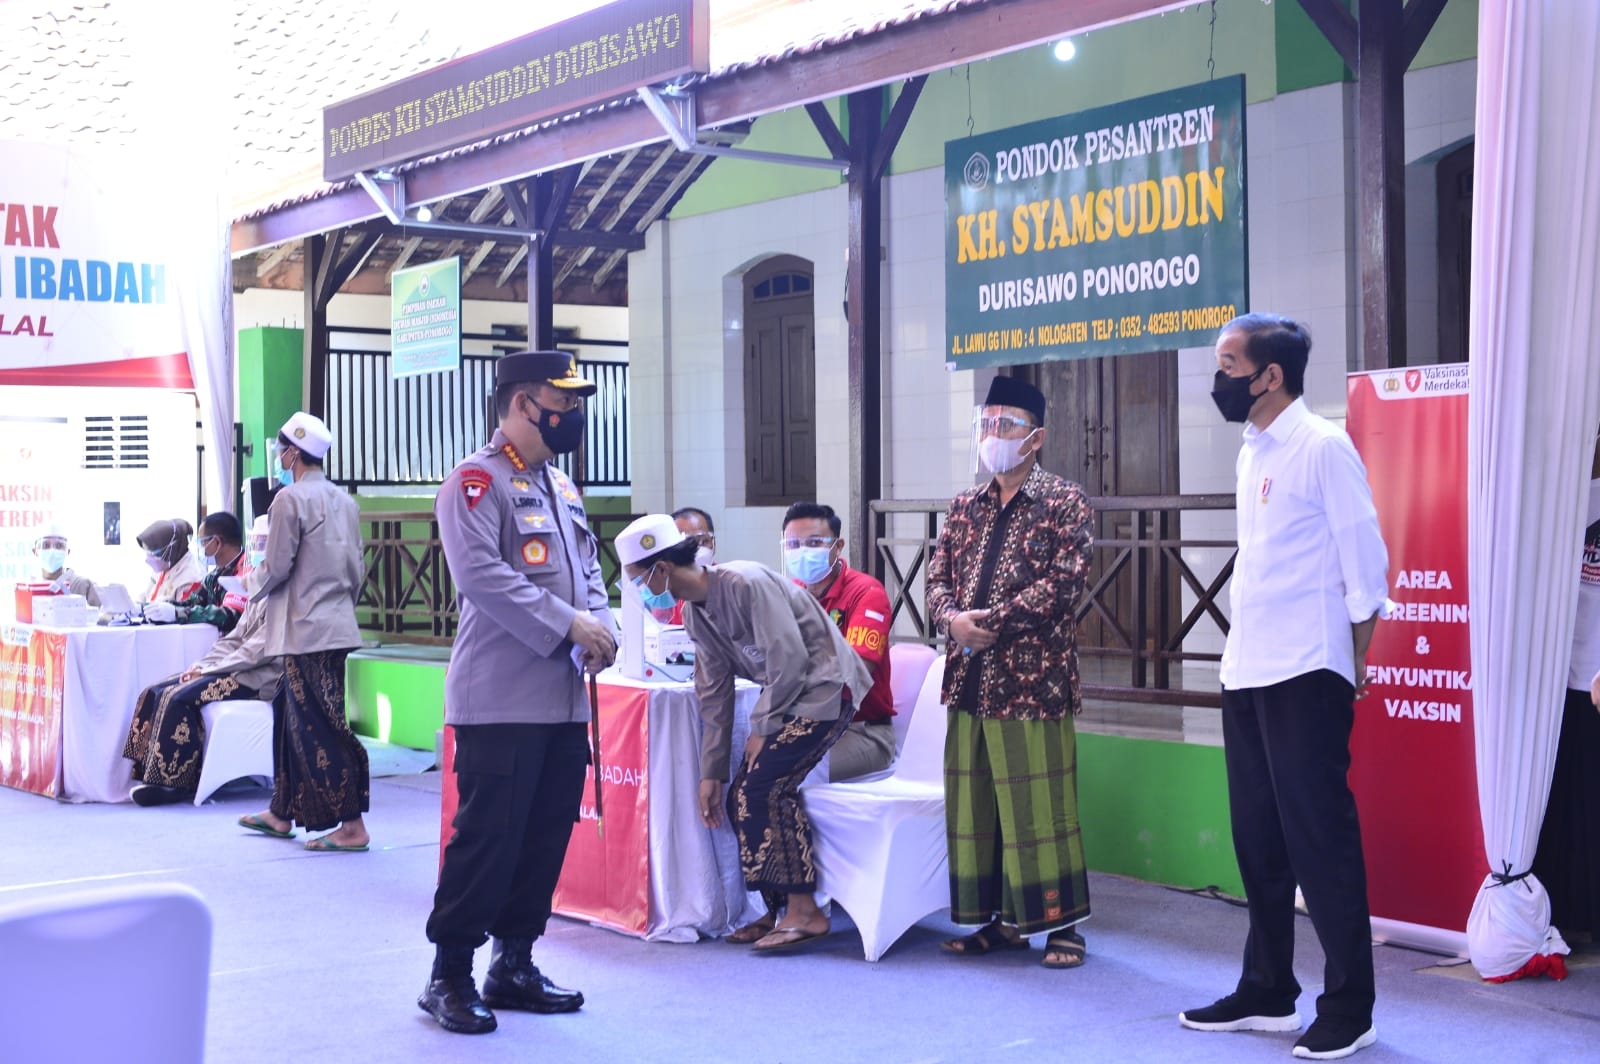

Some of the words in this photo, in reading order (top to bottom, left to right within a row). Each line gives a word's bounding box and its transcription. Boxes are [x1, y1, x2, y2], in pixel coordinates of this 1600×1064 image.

[329, 111, 393, 157] PONPES
[394, 100, 422, 138] KH
[424, 54, 552, 126] SYAMSUDDIN
[554, 13, 681, 86] DURISAWO
[995, 135, 1079, 184] PONDOK
[1084, 105, 1215, 165] PESANTREN
[956, 208, 1005, 265] KH.
[1012, 166, 1225, 255] SYAMSUDDIN
[14, 255, 166, 305] IBADAH
[978, 271, 1077, 313] DURISAWO
[1083, 254, 1200, 298] PONOROGO
[952, 335, 963, 355] JL.
[965, 332, 987, 354] LAWU
[988, 330, 999, 351] GG
[1001, 329, 1010, 350] IV
[1038, 321, 1087, 347] NOLOGATEN
[1091, 318, 1113, 341] TELP
[1120, 314, 1142, 339] 0352
[1148, 310, 1180, 336] 482593
[1182, 304, 1236, 332] PONOROGO
[1424, 365, 1469, 380] Vaksinasi
[1395, 570, 1452, 589] AREA
[1380, 603, 1470, 623] REENIN
[1416, 635, 1430, 655] &
[1384, 698, 1461, 723] VAKSIN
